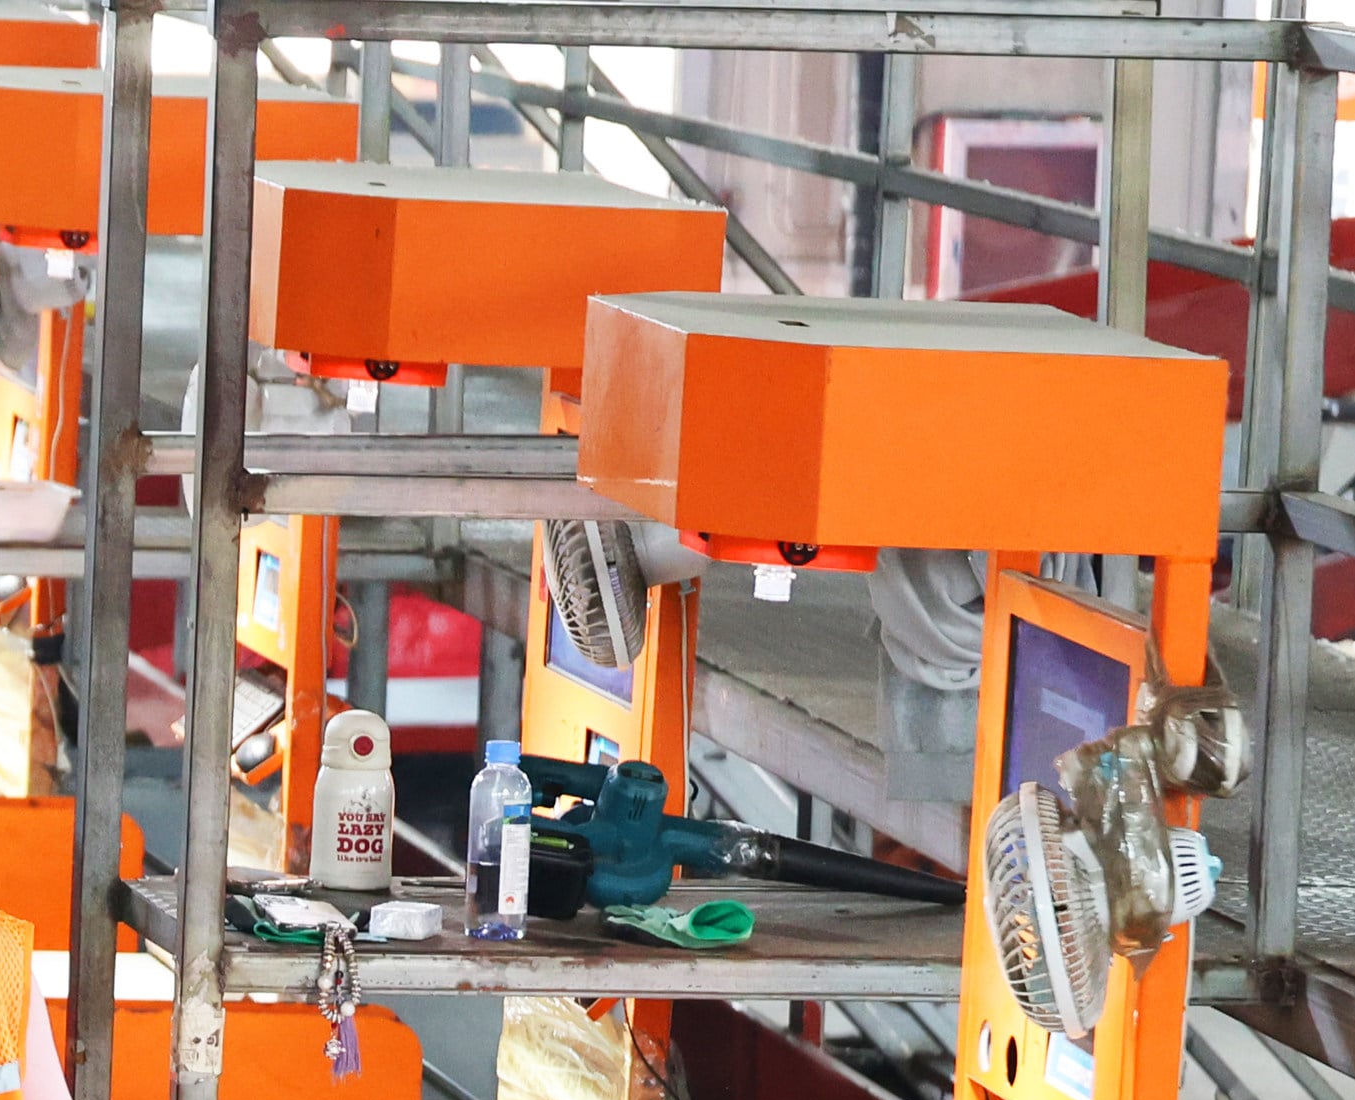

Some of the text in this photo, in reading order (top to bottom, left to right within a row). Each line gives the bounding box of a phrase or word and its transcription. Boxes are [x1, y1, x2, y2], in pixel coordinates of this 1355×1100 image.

[337, 812, 364, 822] YOU
[337, 823, 385, 836] LAZY
[336, 837, 383, 854] DOG
